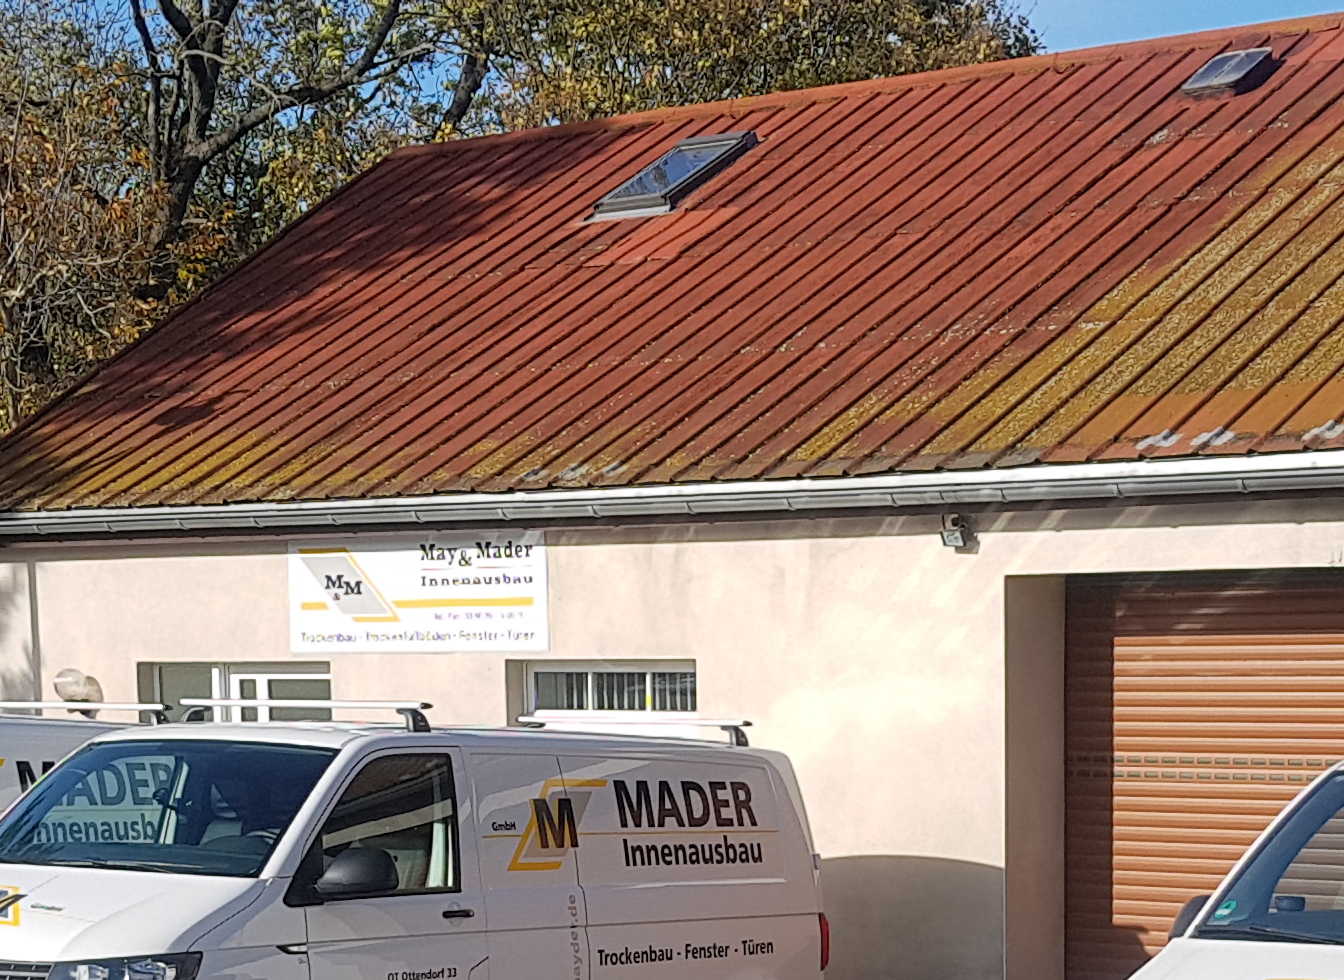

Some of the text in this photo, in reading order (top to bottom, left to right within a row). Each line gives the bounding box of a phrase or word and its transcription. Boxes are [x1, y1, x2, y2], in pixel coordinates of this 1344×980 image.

[420, 541, 533, 566] May & Mader
[325, 574, 344, 589] M
[343, 580, 362, 595] M
[421, 573, 533, 587] Innenausbau
[613, 780, 758, 828] MADER
[492, 821, 516, 831] GmbH
[622, 835, 763, 867] Innenausbau
[597, 945, 673, 966] Trockenbau
[684, 943, 730, 960] Fenster
[741, 939, 774, 955] Türen
[401, 968, 445, 980] Ottendorf
[447, 968, 457, 978] 33
